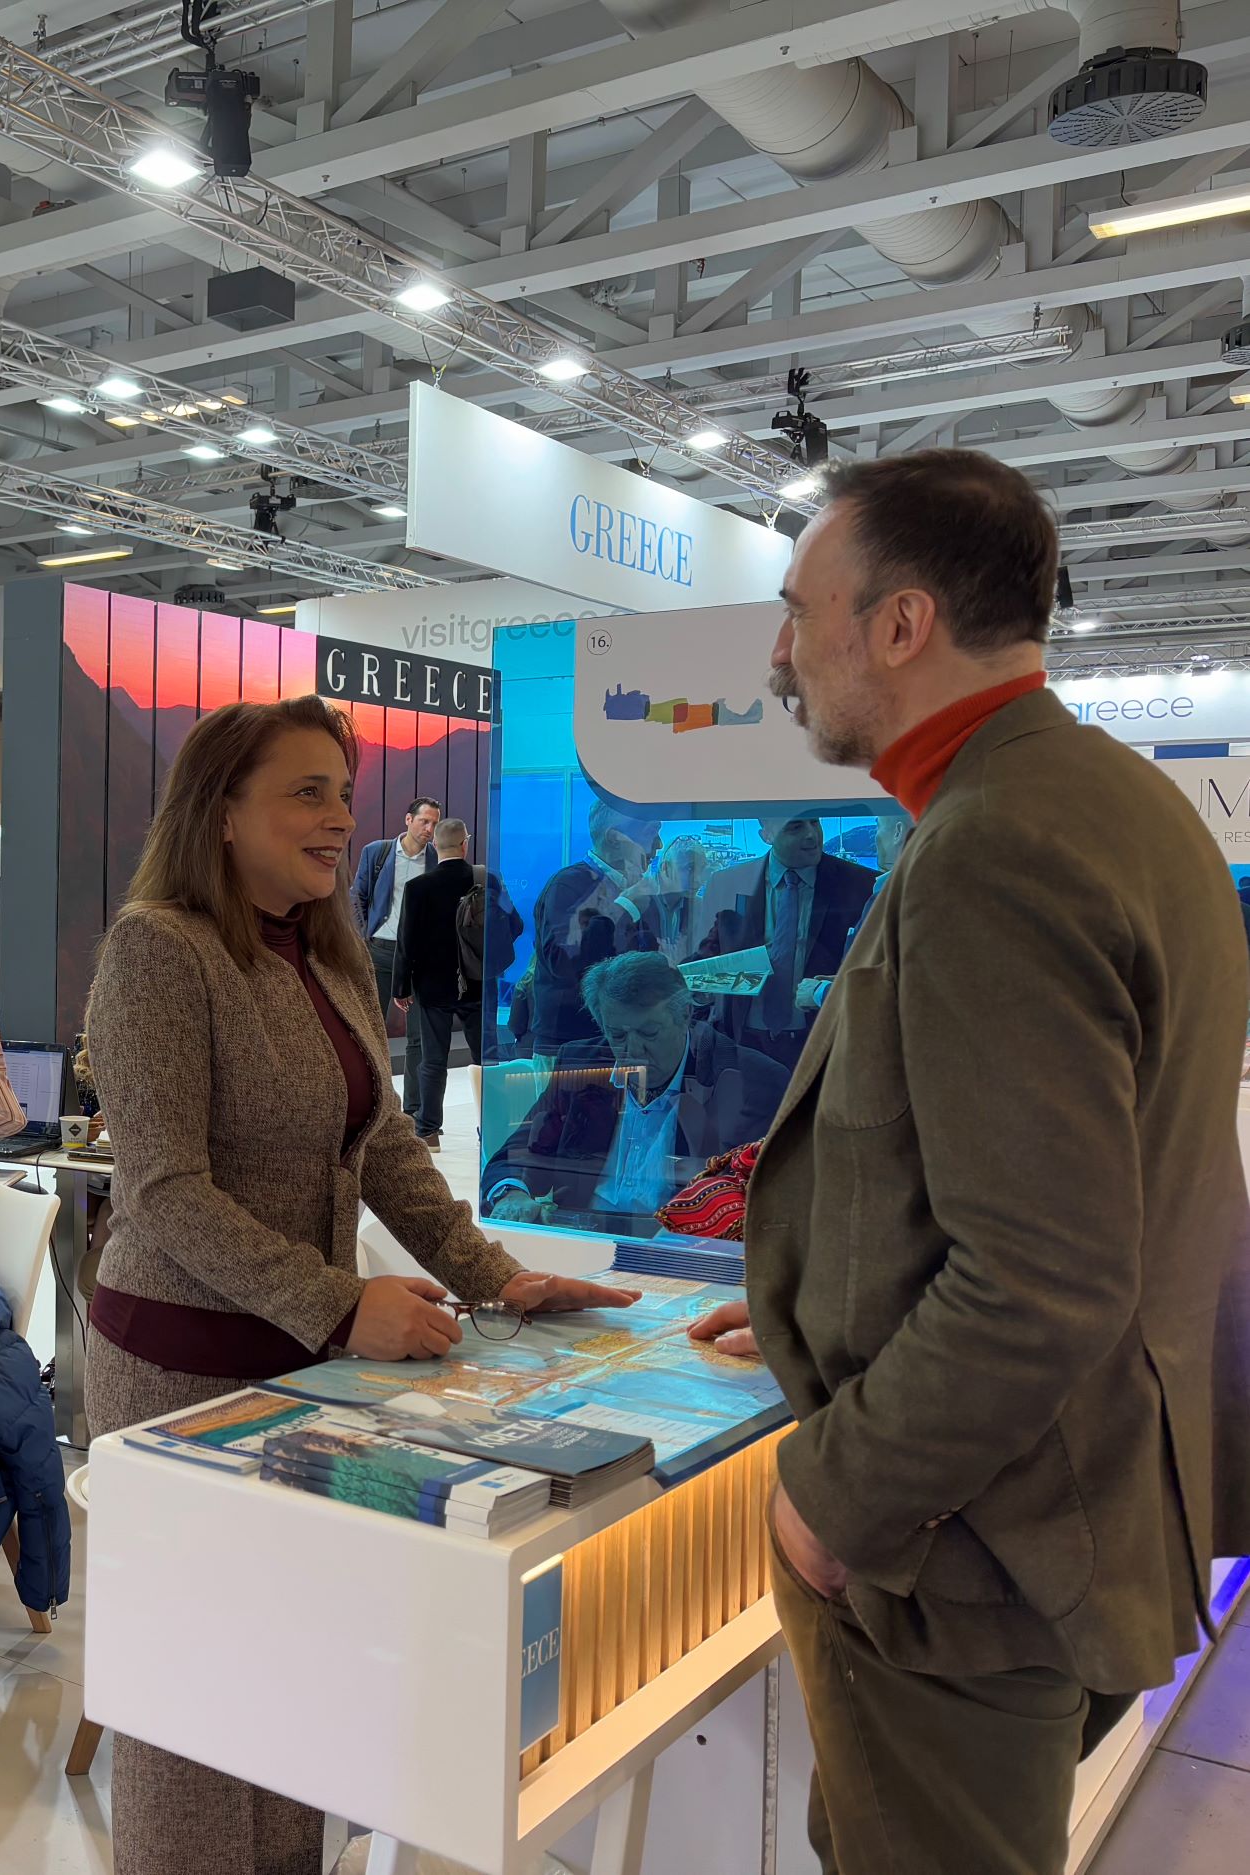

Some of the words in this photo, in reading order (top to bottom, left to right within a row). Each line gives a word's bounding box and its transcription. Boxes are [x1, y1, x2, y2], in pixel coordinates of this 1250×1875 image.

[570, 494, 692, 587] GREECE
[326, 648, 492, 714] GREECE
[465, 1419, 554, 1448] KRETA
